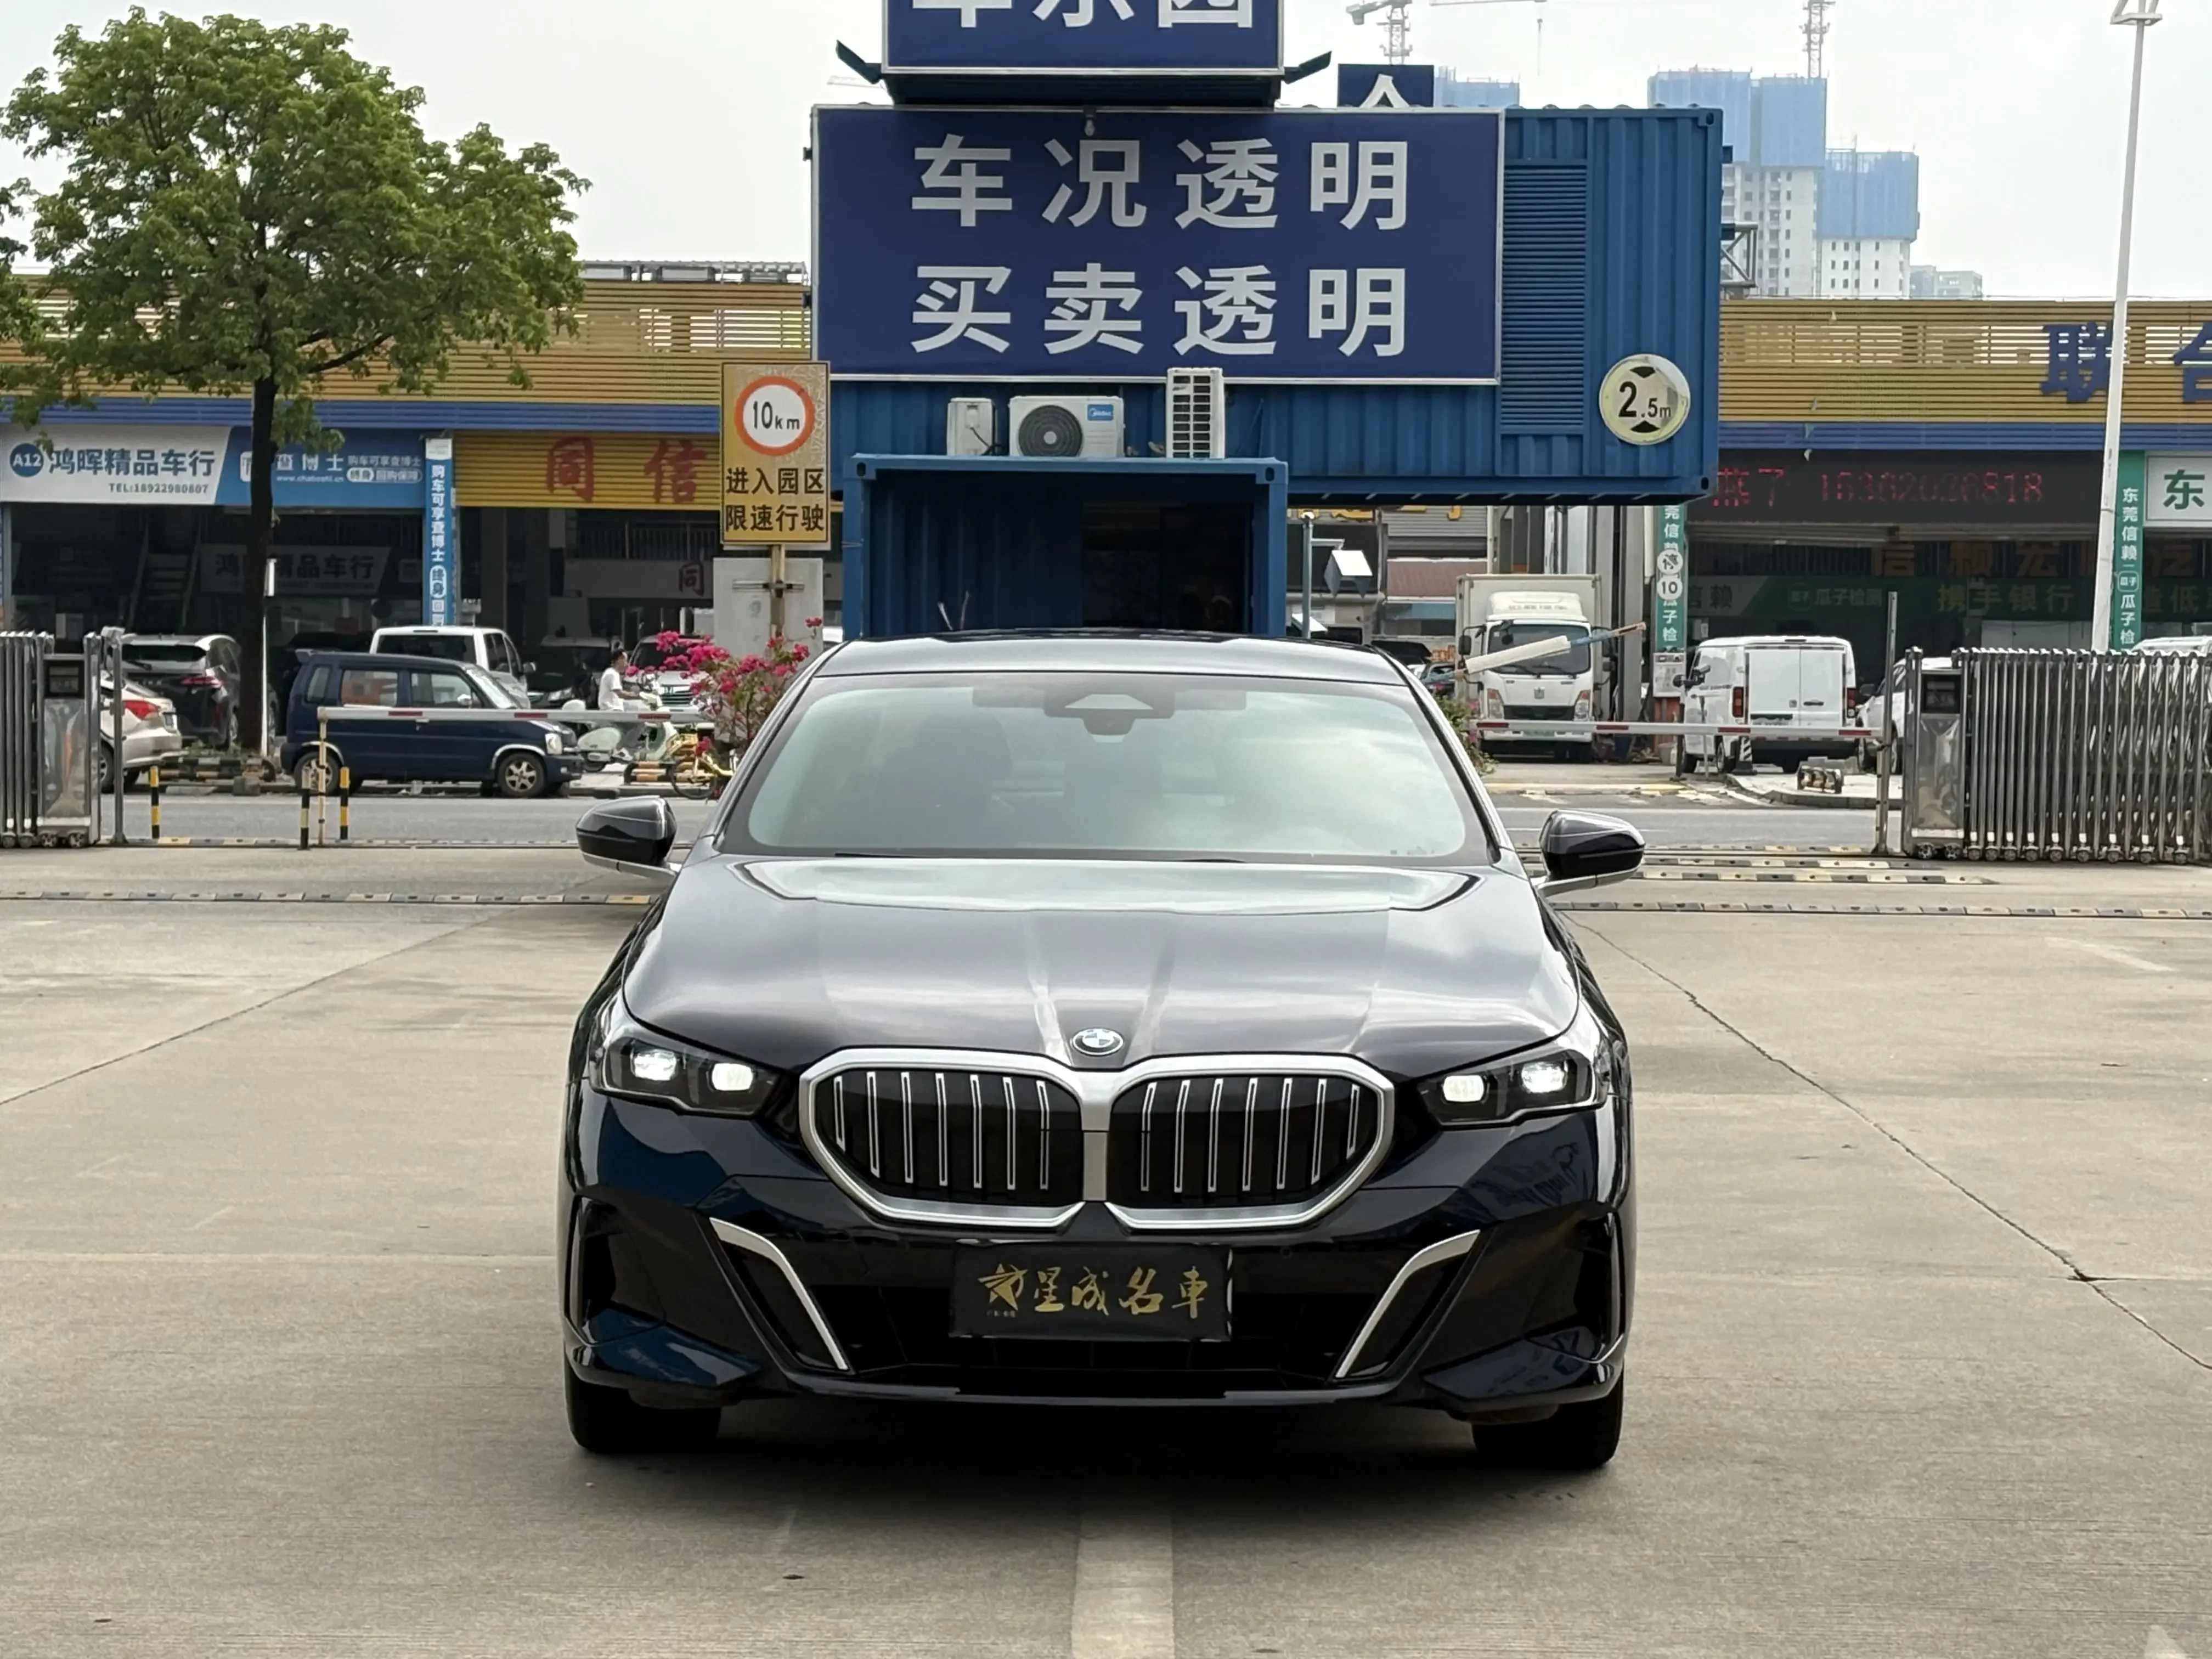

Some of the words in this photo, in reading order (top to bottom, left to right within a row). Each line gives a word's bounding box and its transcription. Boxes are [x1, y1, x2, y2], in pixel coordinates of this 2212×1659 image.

[911, 133, 1408, 230] 车况透明
[911, 262, 1407, 357] 买卖透明
[753, 401, 800, 430] 10km
[1618, 381, 1672, 417] 2.5m
[12, 453, 42, 467] A12
[49, 447, 216, 477] 鸿晖精品车行
[546, 436, 707, 504] 同信
[726, 467, 825, 495] 进入园区
[2163, 469, 2205, 510] 东
[726, 504, 825, 532] 限速行驶
[678, 560, 706, 597] 同
[1661, 581, 1678, 594] 10
